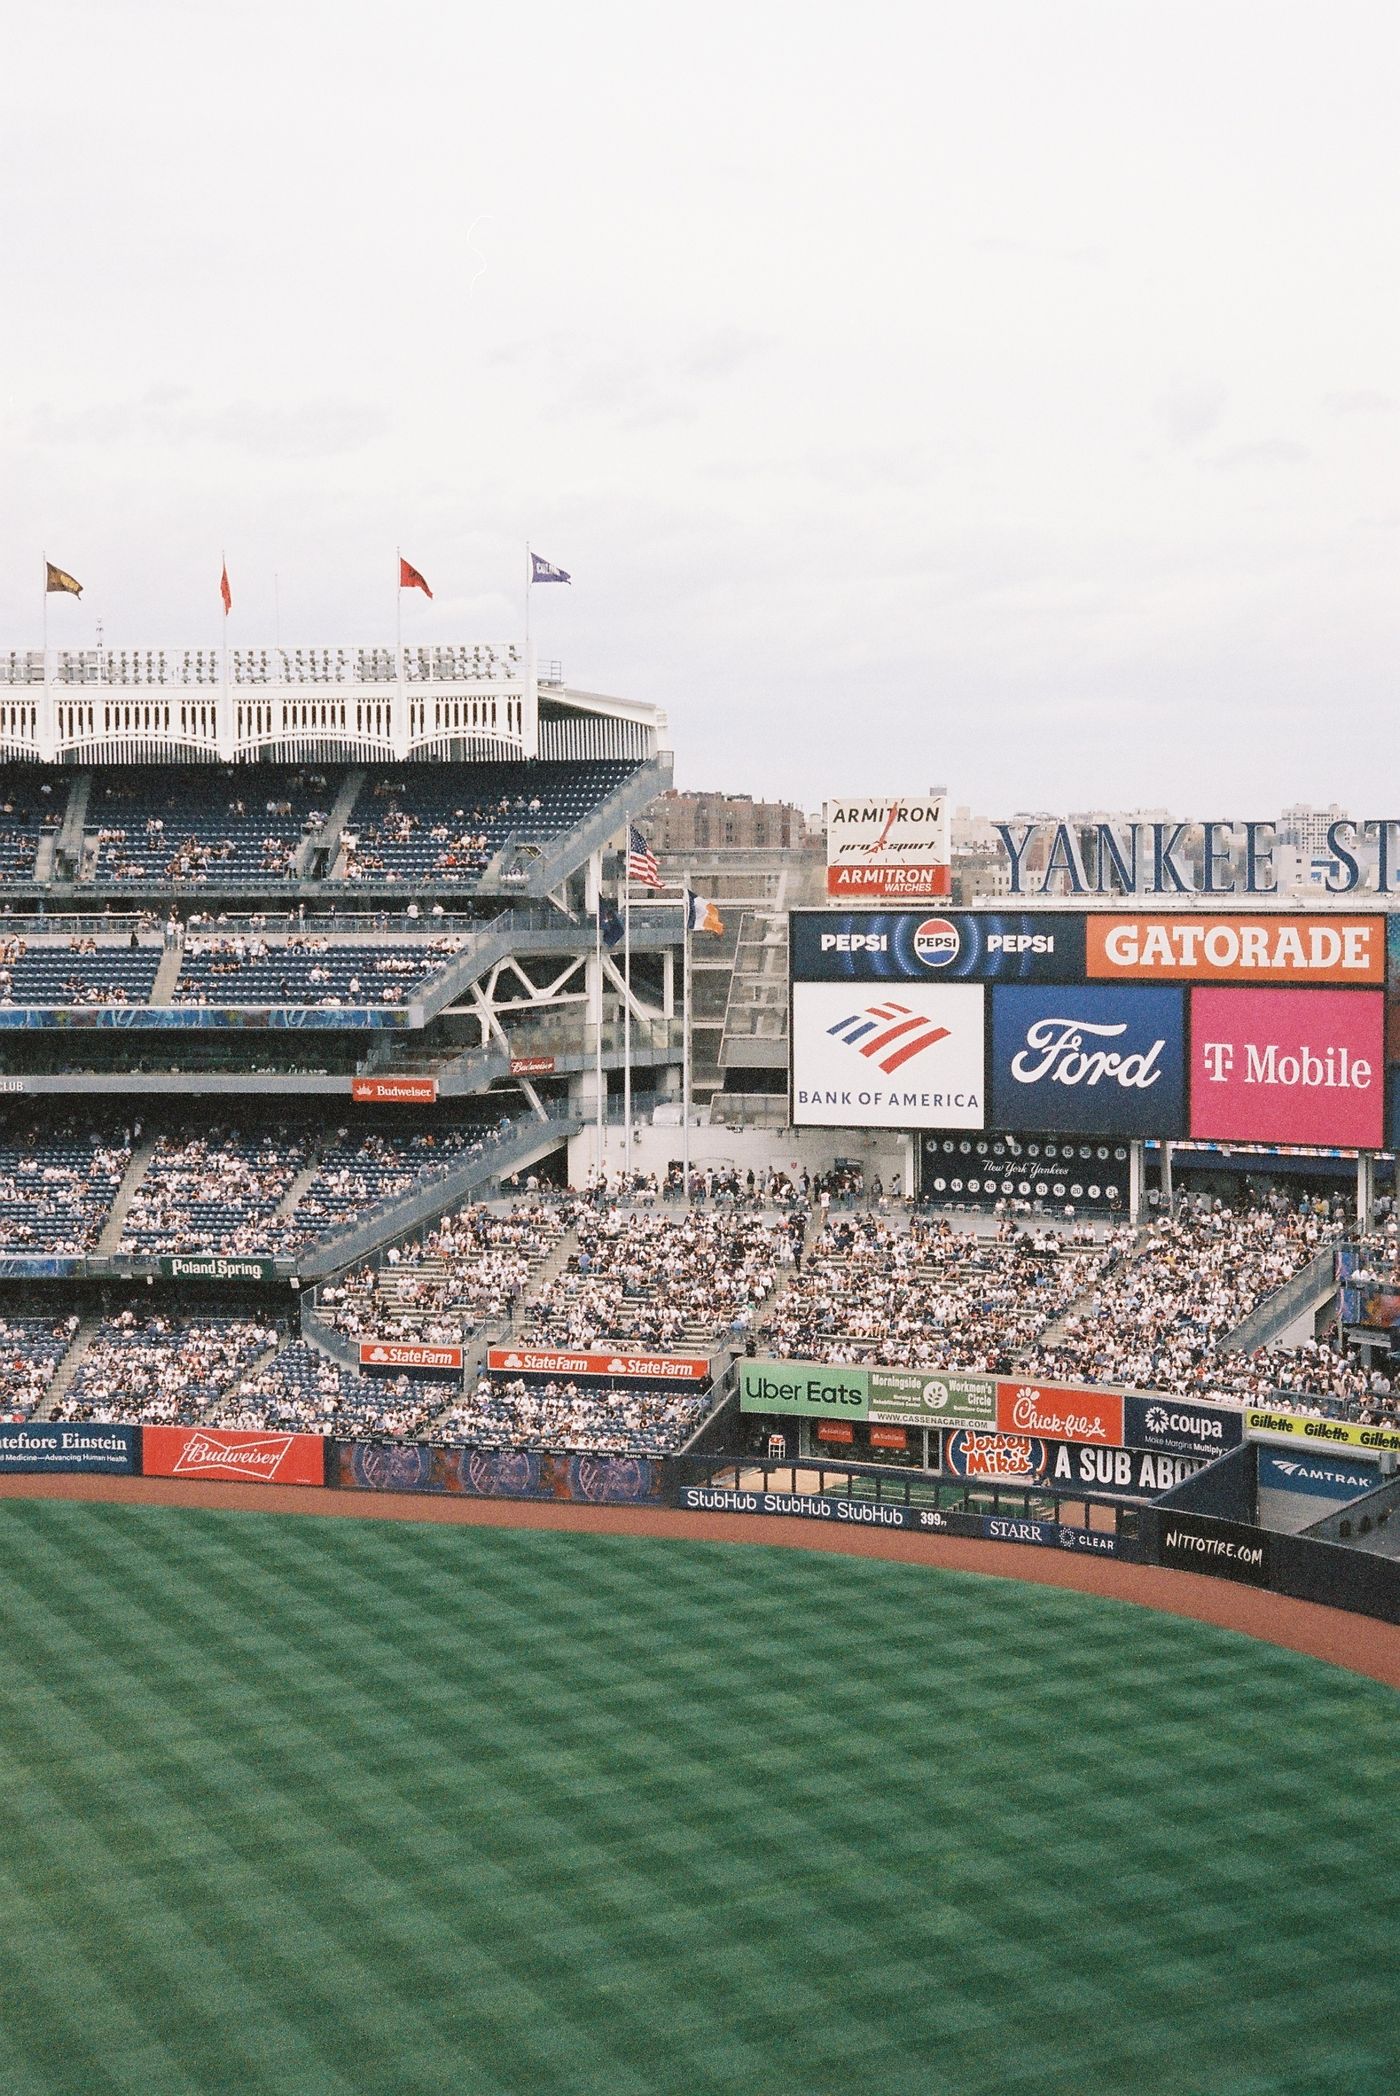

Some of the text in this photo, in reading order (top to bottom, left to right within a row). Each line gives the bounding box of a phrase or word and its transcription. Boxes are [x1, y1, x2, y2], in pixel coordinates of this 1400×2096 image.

[888, 841, 935, 852] sport
[992, 819, 1400, 894] YANKEE ST
[838, 869, 933, 884] ARMITRON
[884, 883, 932, 893] WATCHES
[821, 933, 887, 951] PEPSI
[917, 937, 957, 948] PEPSI
[987, 934, 1054, 953] PEPSI
[1105, 925, 1370, 968] GATORADE
[1011, 1018, 1166, 1088] Ford
[1204, 1043, 1372, 1089] T Mobile
[377, 1085, 431, 1097] Budweiser
[799, 1091, 979, 1108] BANK OF AMERICA
[982, 1160, 1069, 1178] New York Yankees
[172, 1259, 262, 1279] Poland Spring
[746, 1377, 862, 1405] Uber Eats
[872, 1374, 921, 1390] Morningside
[949, 1380, 992, 1394] Workmen's
[967, 1393, 992, 1406] Circle
[877, 1413, 988, 1429] WWW.CASSENACARE.COM
[1013, 1397, 1107, 1438] Chick-fil-A
[1170, 1414, 1222, 1440] coupa
[1250, 1414, 1293, 1433] Gillette
[1304, 1423, 1349, 1442] Gillette
[61, 1432, 127, 1450] Einstein
[960, 1430, 1032, 1456] Jersey
[1145, 1435, 1223, 1456] Make Margins Multiply
[83, 1454, 106, 1462] Human
[107, 1455, 127, 1463] Health
[183, 1443, 281, 1465] Budweiser
[966, 1452, 1033, 1476] Mike's
[1055, 1445, 1072, 1479] A
[1079, 1449, 1132, 1486] SUB
[1298, 1468, 1370, 1487] AMTRAK
[687, 1491, 903, 1524] StubHub StubHub StubHub
[920, 1512, 941, 1526] 399
[989, 1520, 1042, 1542] STARR
[1078, 1535, 1114, 1550] CLEAR
[1166, 1530, 1263, 1567] NITTOTIRE.COM
